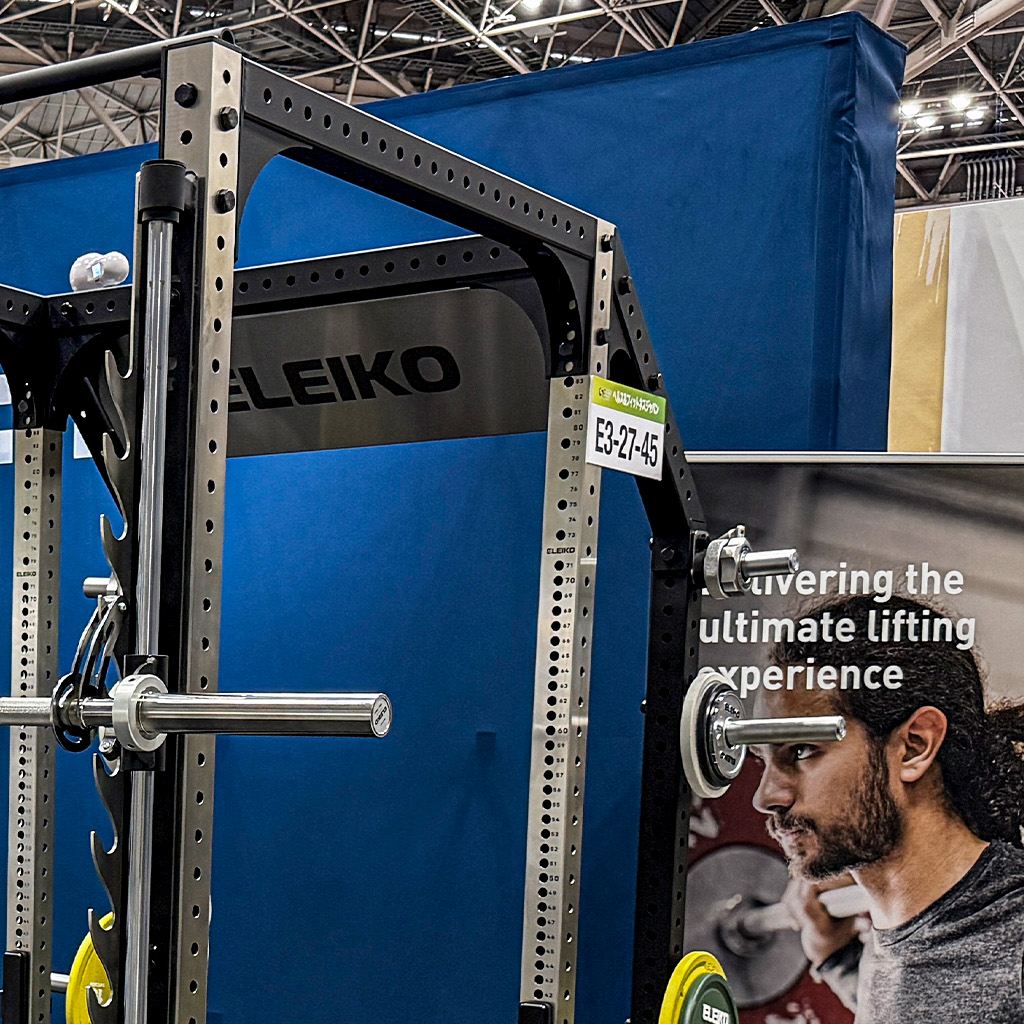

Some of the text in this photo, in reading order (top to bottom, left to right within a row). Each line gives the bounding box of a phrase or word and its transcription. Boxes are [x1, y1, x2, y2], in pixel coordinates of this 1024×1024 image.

[595, 417, 659, 468] E3-27-45
[906, 562, 964, 595] the
[700, 610, 976, 650] ultimate lifting
